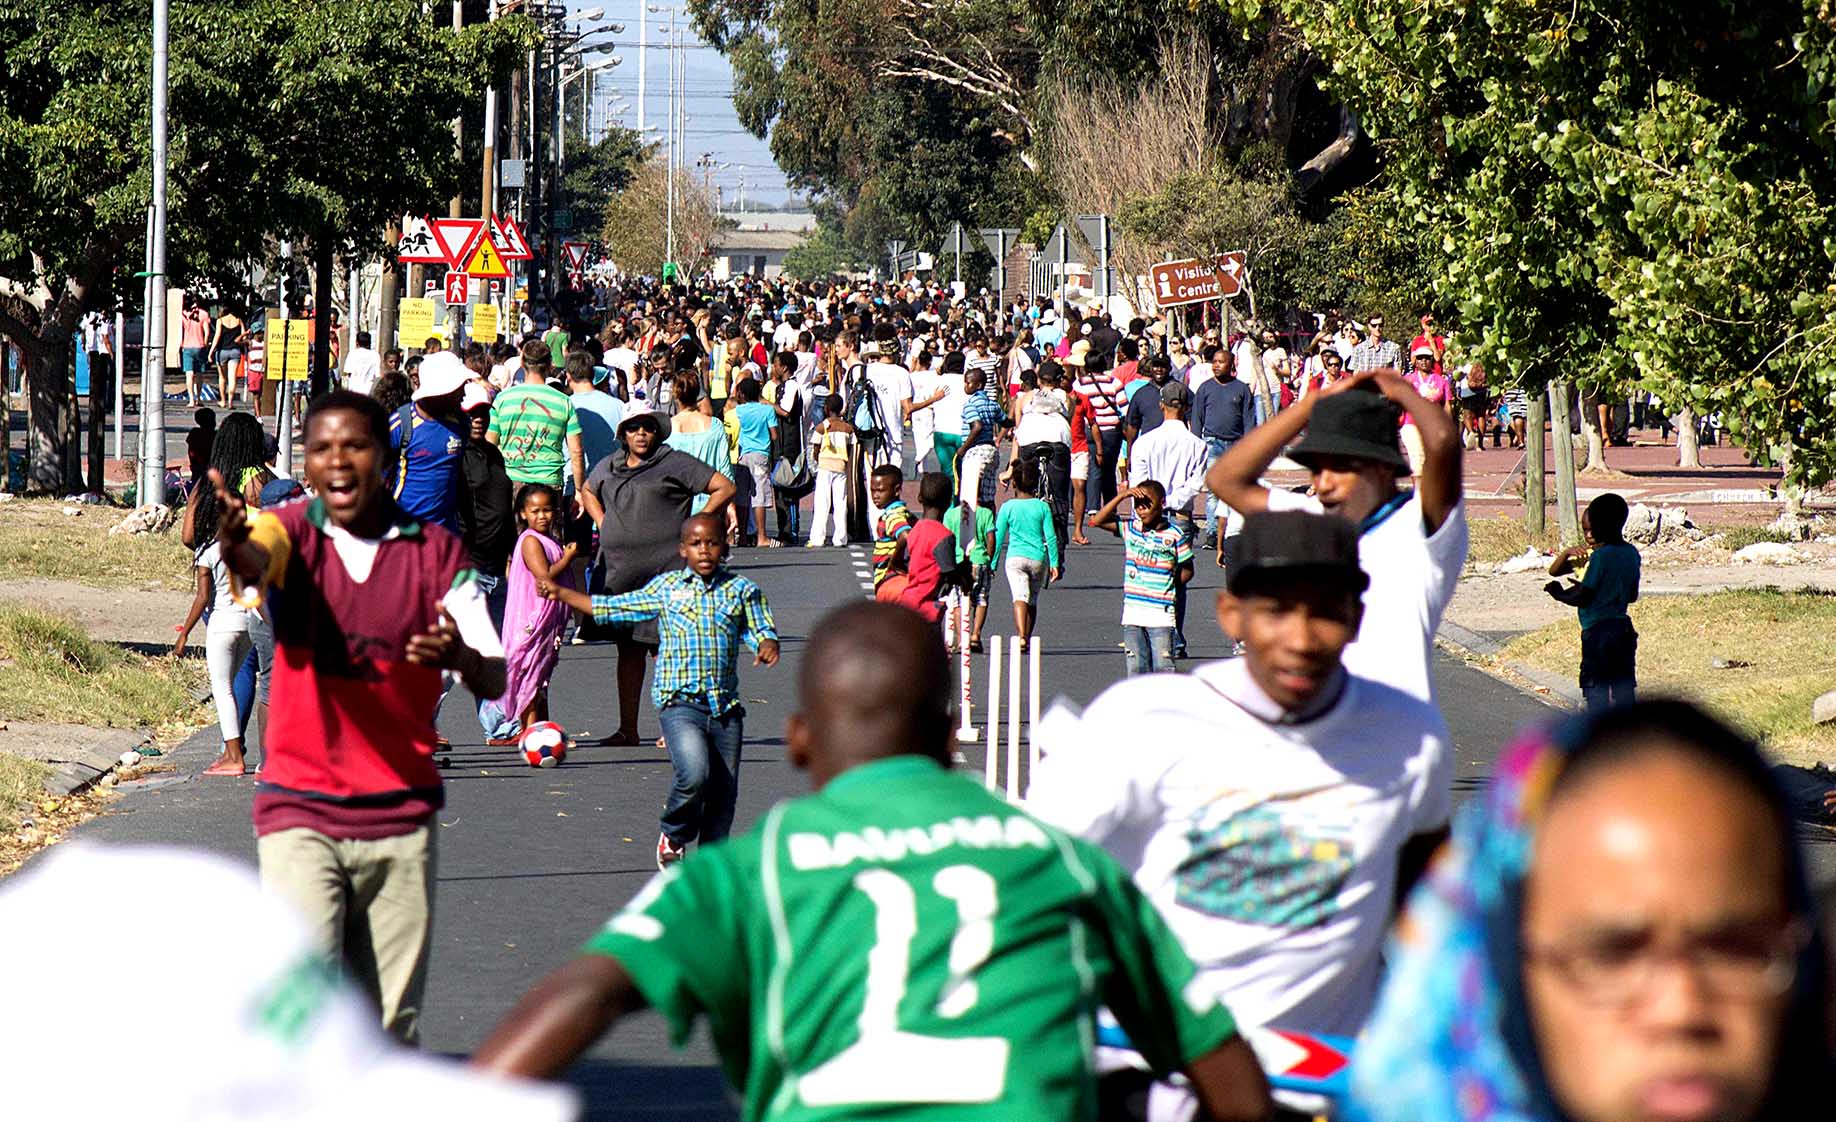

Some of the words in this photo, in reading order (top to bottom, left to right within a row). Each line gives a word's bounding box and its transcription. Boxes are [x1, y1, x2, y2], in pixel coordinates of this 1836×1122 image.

[1178, 281, 1220, 298] Centre
[402, 309, 432, 317] PARKING
[787, 815, 1051, 871] BAVUMA
